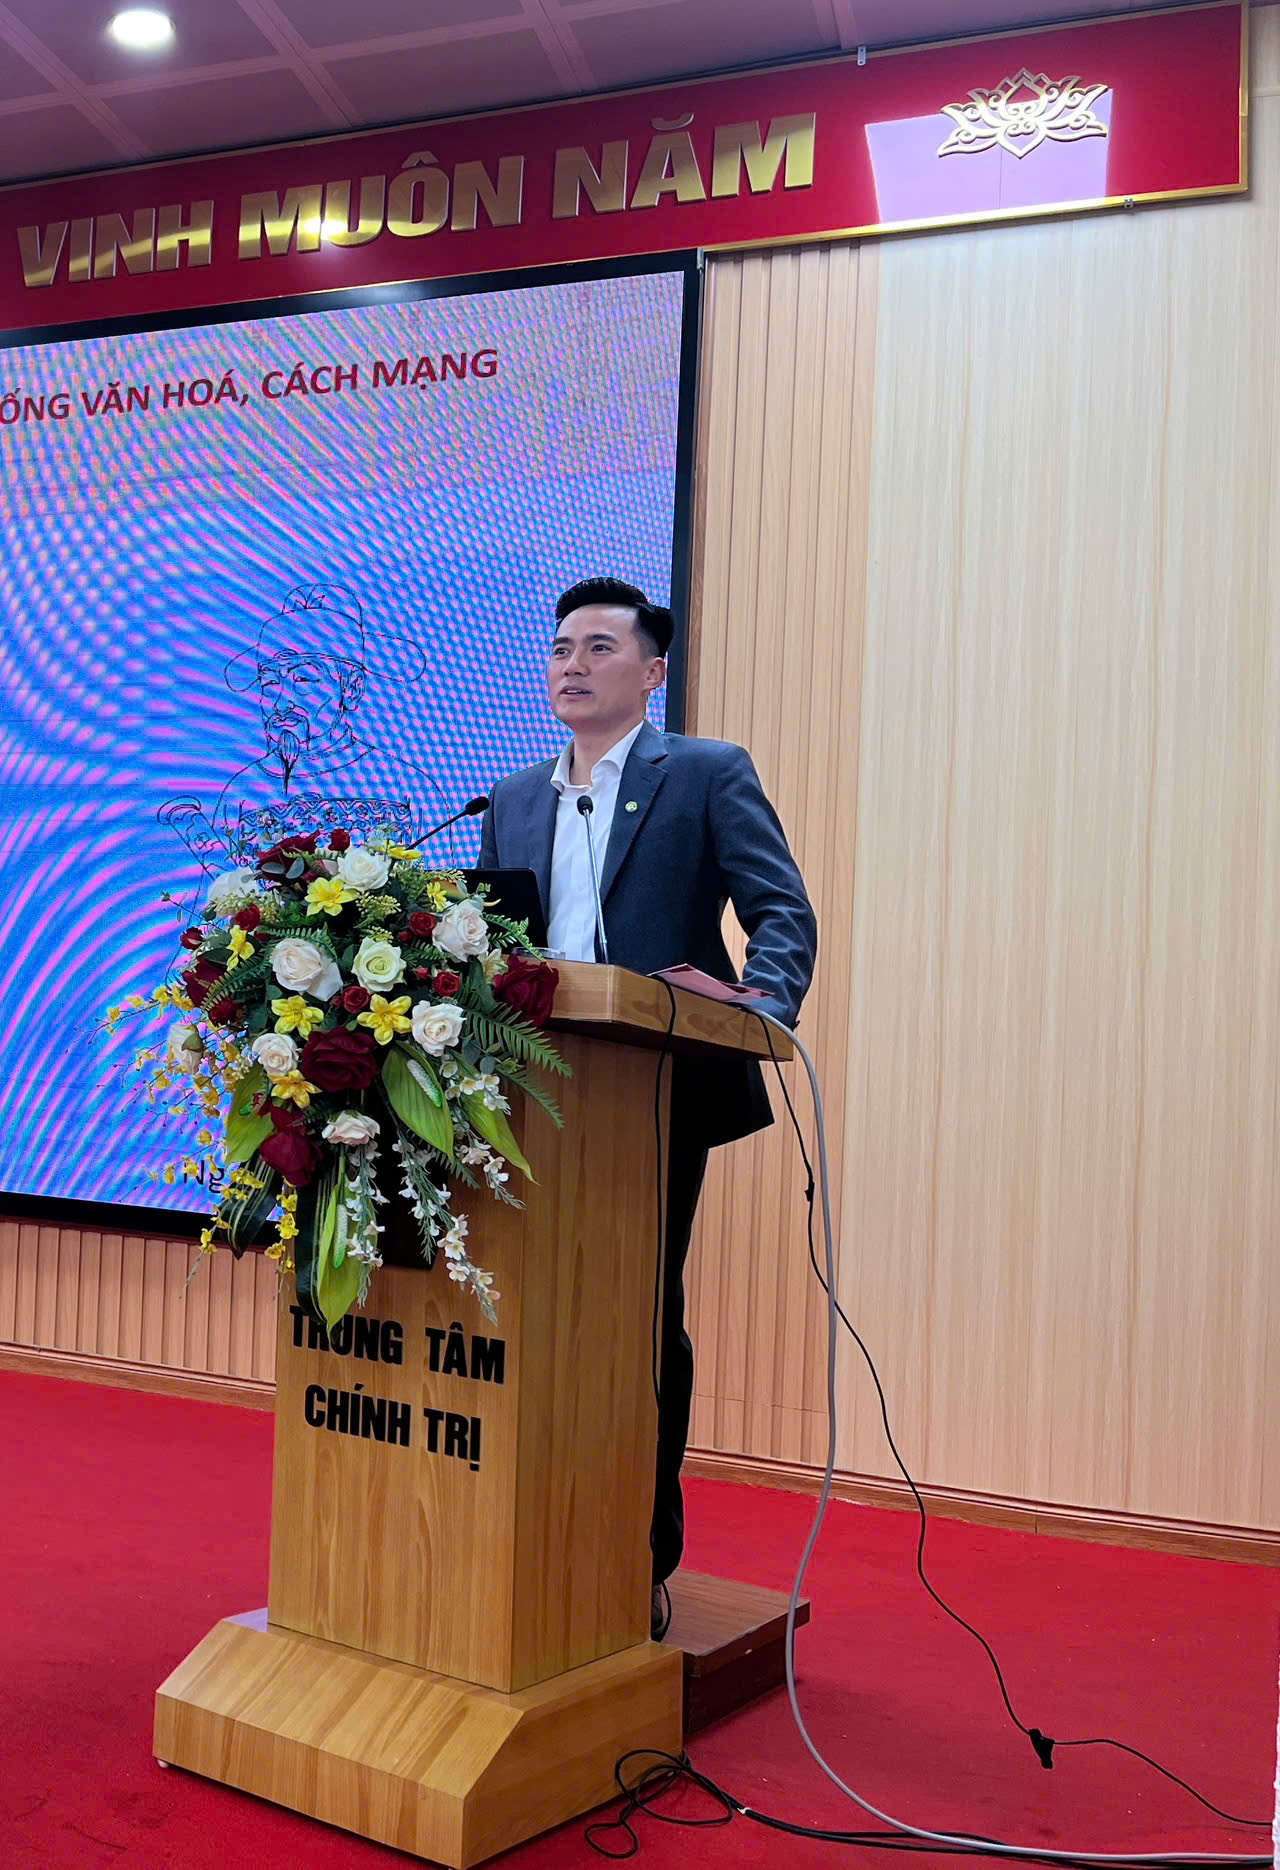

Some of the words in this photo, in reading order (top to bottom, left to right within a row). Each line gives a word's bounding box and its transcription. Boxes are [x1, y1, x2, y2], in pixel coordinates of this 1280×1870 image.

[19, 200, 214, 288] VINH
[238, 151, 525, 261] MUÔN
[552, 112, 817, 221] NĂM
[81, 382, 150, 417] VĂN
[162, 368, 250, 409] HOÁ,
[261, 362, 358, 400] CÁCH
[372, 349, 499, 391] MẠNG
[425, 1321, 506, 1385] TÂM
[304, 1383, 412, 1448] CHÍNH
[423, 1407, 481, 1472] TRỊ
